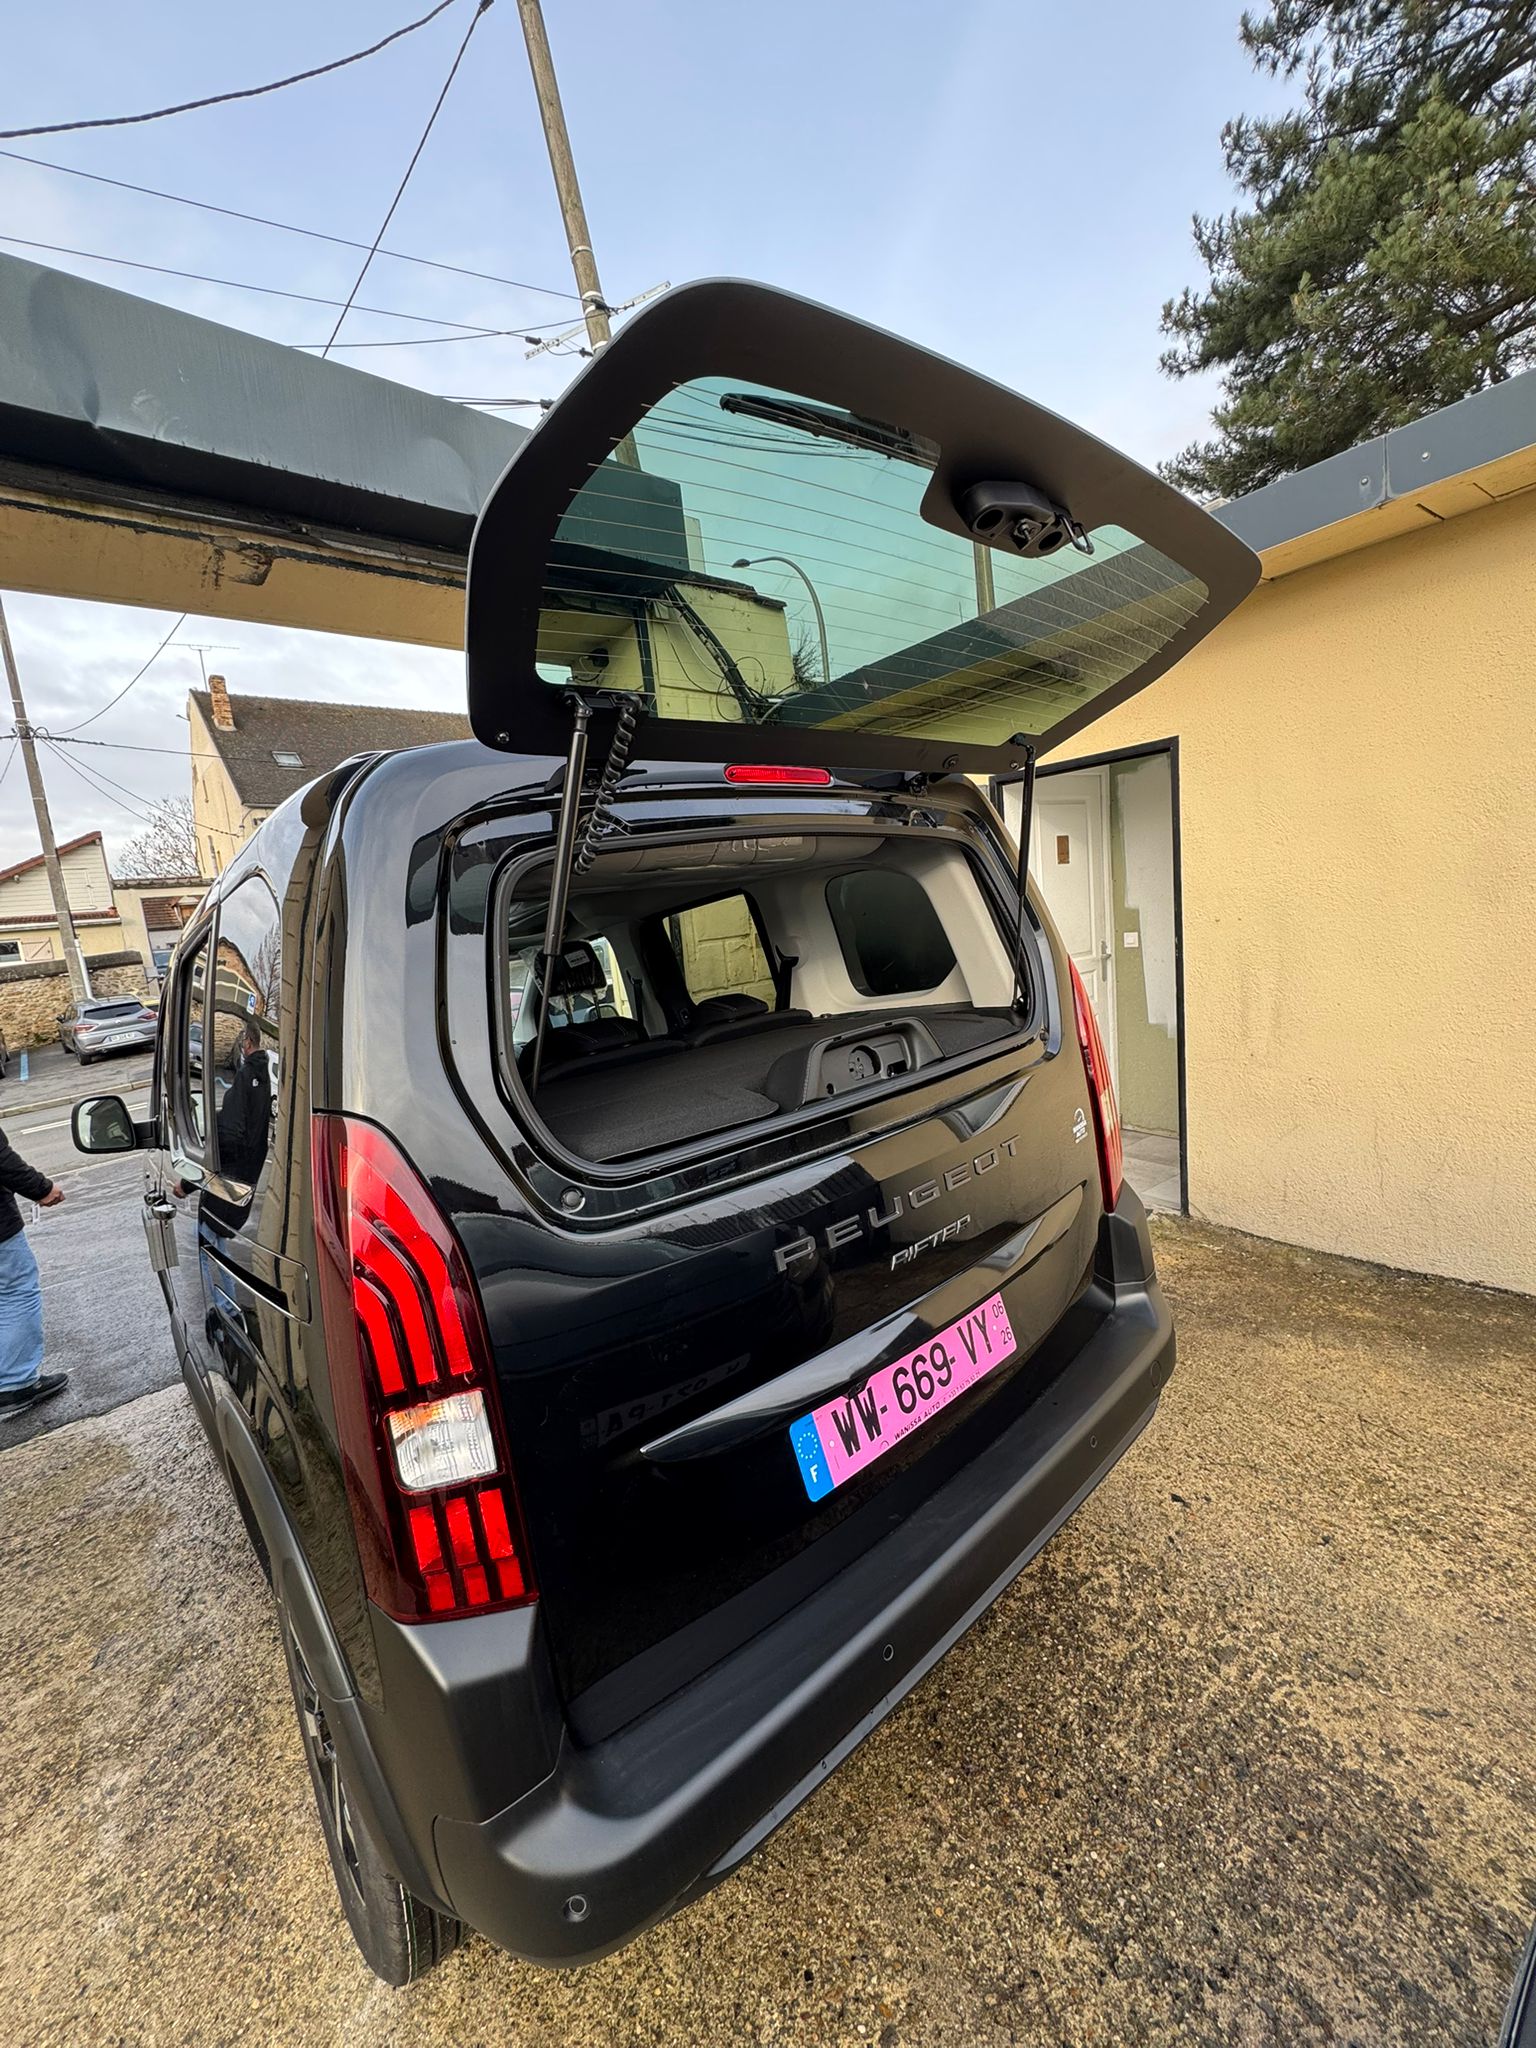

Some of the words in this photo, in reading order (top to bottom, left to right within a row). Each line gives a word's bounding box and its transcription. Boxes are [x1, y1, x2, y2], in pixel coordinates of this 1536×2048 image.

[773, 1134, 1021, 1273] PEUGEOT
[891, 1214, 971, 1271] RIFTER
[992, 1301, 1004, 1318] 06
[1001, 1327, 1013, 1345] 26
[924, 1401, 940, 1418] AUTO
[810, 1464, 818, 1483] F
